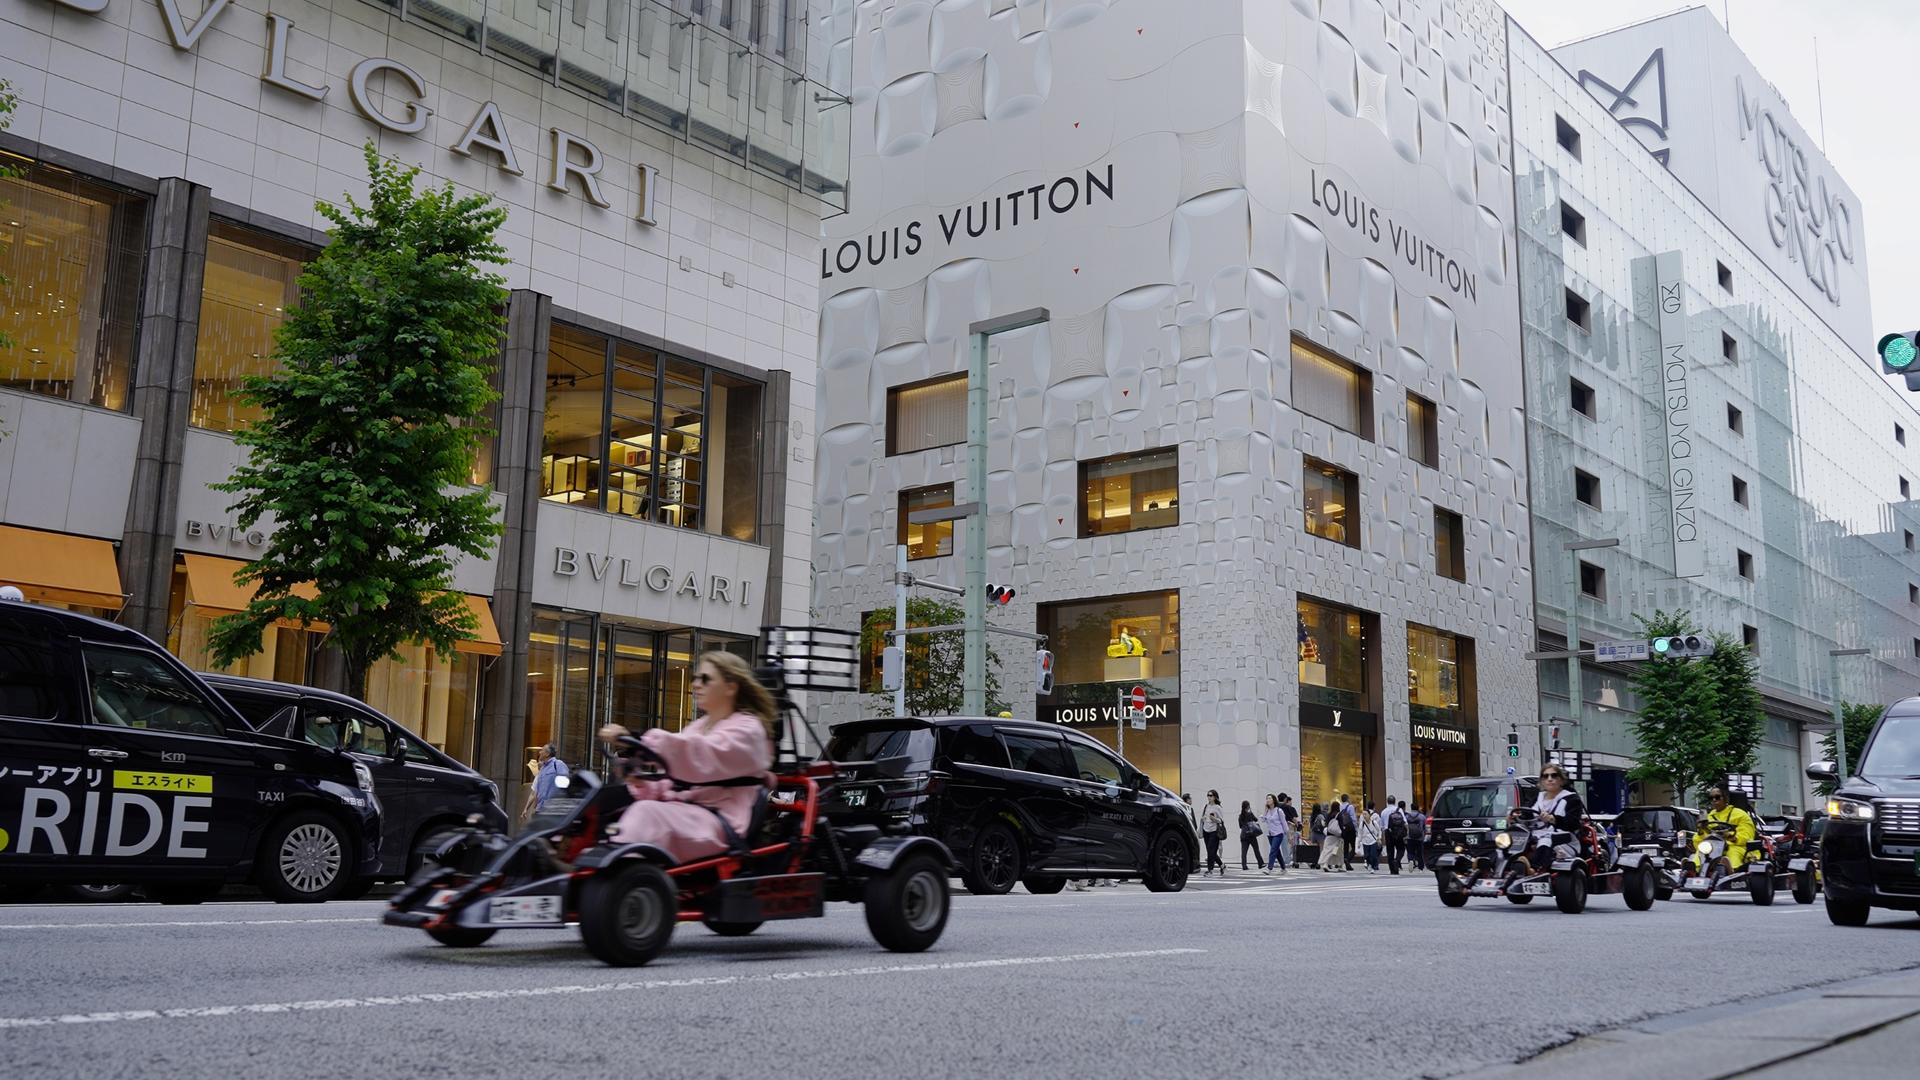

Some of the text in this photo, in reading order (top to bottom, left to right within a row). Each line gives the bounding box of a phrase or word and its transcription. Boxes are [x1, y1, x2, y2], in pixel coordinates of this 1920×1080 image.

[45, 0, 660, 226] VLGARI
[821, 164, 1114, 279] LOUIS VUITTON
[1311, 168, 1477, 305] LOUIS VUITTON
[187, 520, 265, 547] BVLG
[553, 547, 751, 606] BVLGARI
[1056, 708, 1097, 723] LOUIS
[1102, 703, 1167, 721] VUITON
[1413, 725, 1466, 745] LOUIS VUITTON
[131, 775, 196, 789] エスライド
[258, 790, 285, 802] TAXI
